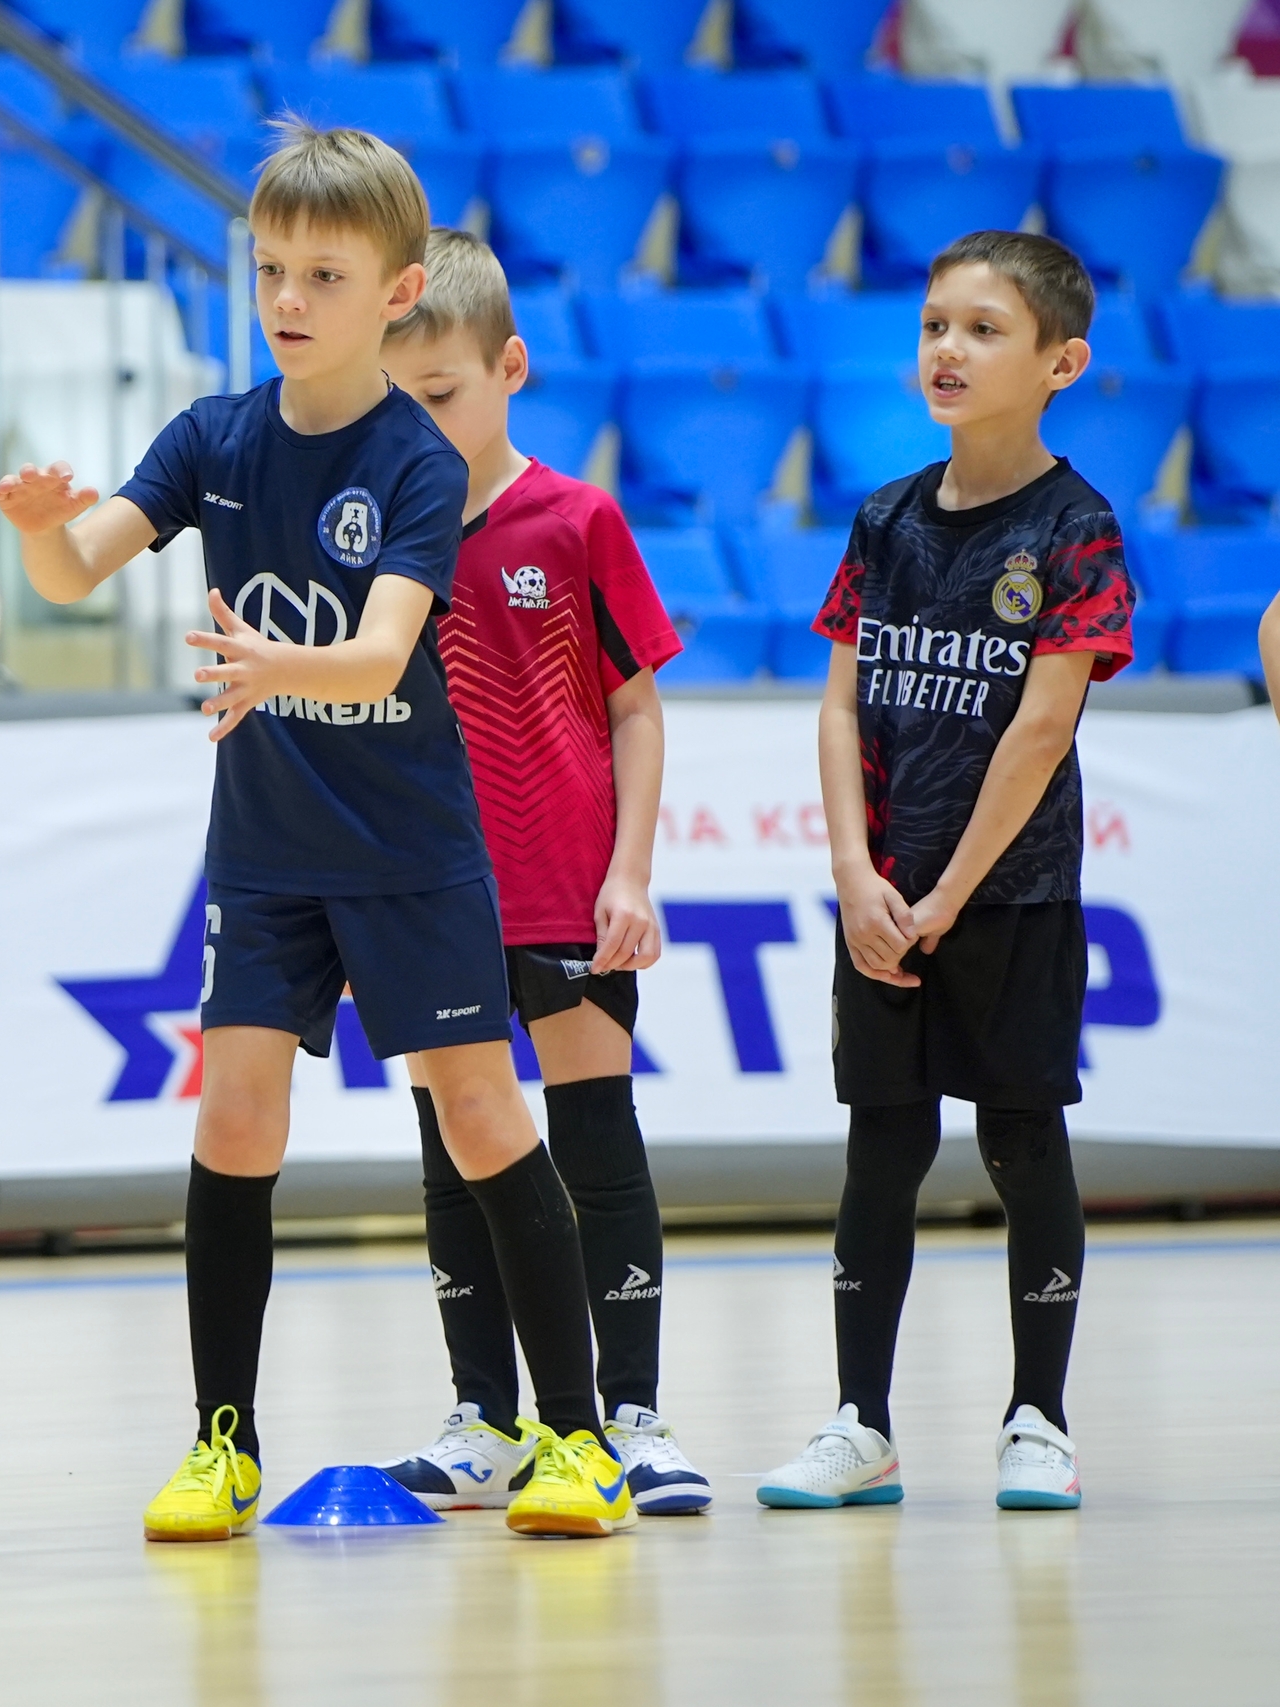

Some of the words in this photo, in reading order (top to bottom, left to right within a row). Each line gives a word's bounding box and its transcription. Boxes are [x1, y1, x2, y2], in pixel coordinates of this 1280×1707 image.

[218, 498, 244, 511] SPORT
[340, 553, 364, 565] АЙКА
[856, 614, 1031, 677] Emirates
[451, 1004, 481, 1018] SPORT
[604, 1285, 662, 1301] DEMIX
[1022, 1288, 1079, 1303] DEMIX
